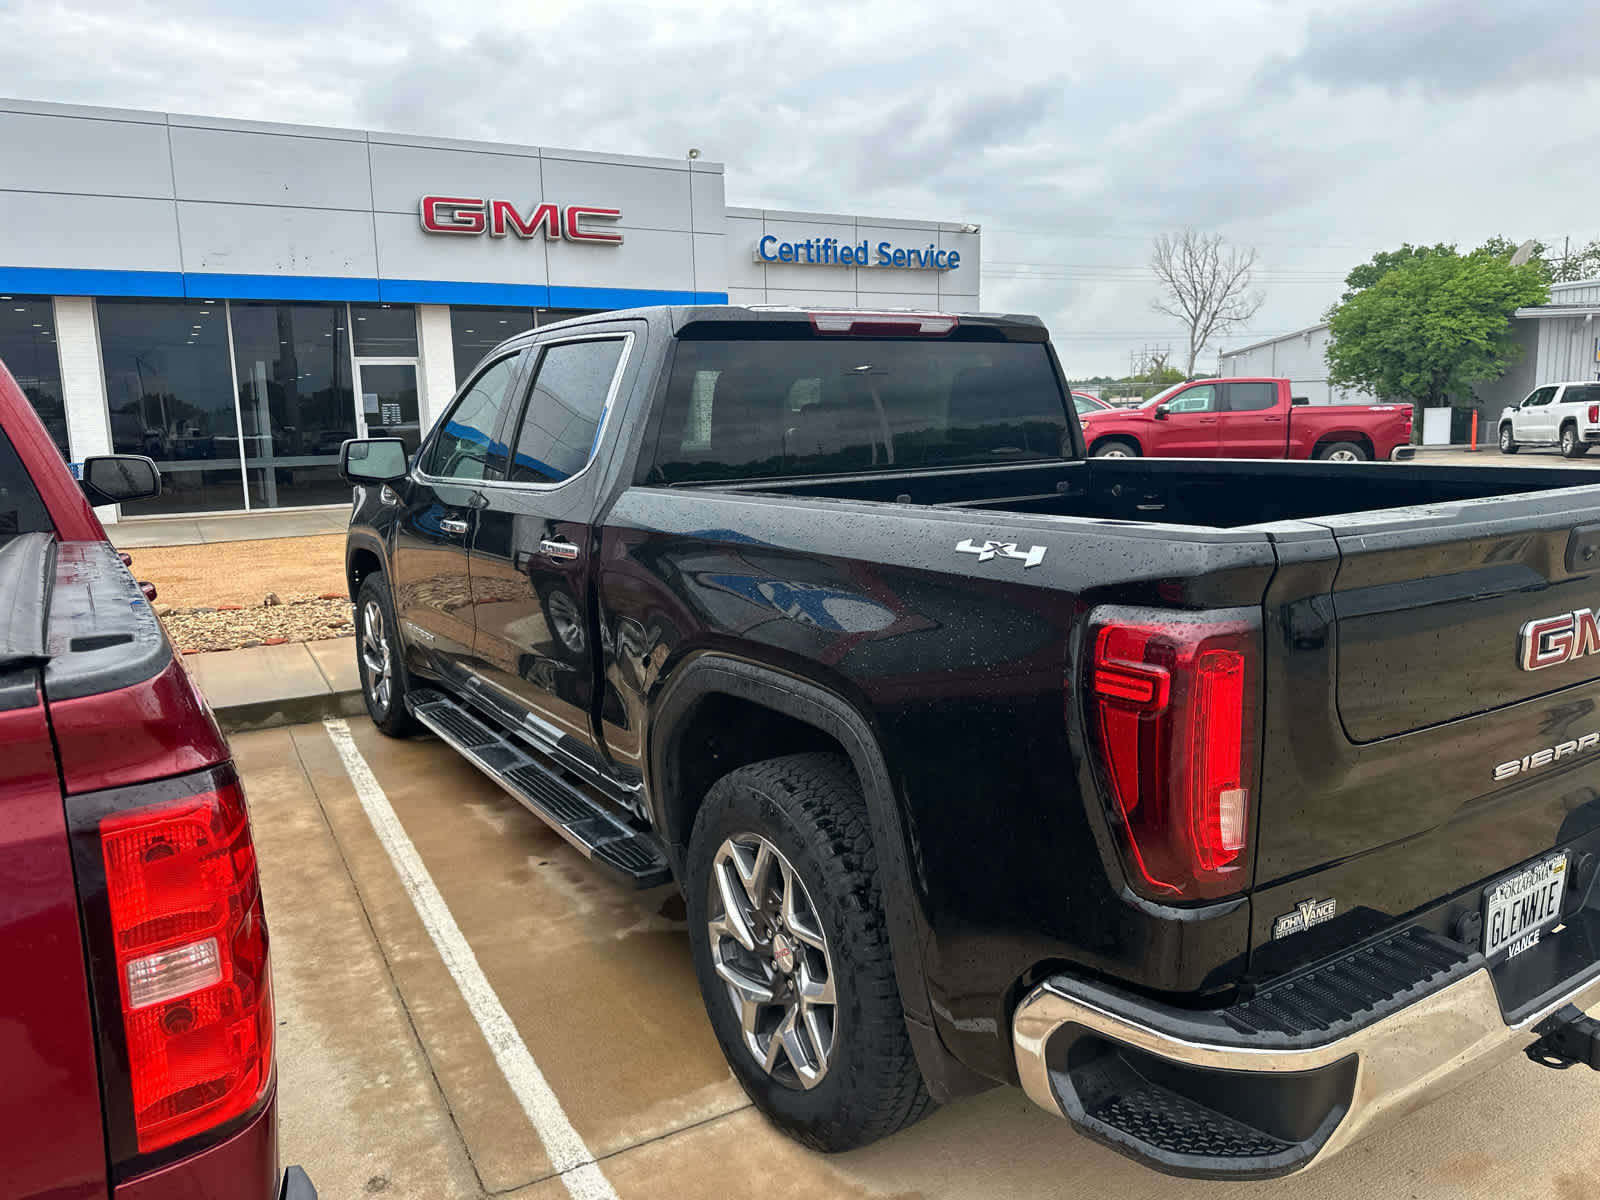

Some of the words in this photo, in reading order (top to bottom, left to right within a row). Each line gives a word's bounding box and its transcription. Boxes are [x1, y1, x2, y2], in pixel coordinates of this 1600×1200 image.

[421, 195, 624, 245] GMC
[760, 234, 869, 266] Certified
[877, 241, 961, 269] Service
[1278, 915, 1303, 931] JOHN
[1299, 901, 1334, 930] VANCE
[1492, 880, 1559, 947] GLENNIE
[1508, 929, 1540, 958] VANCE
